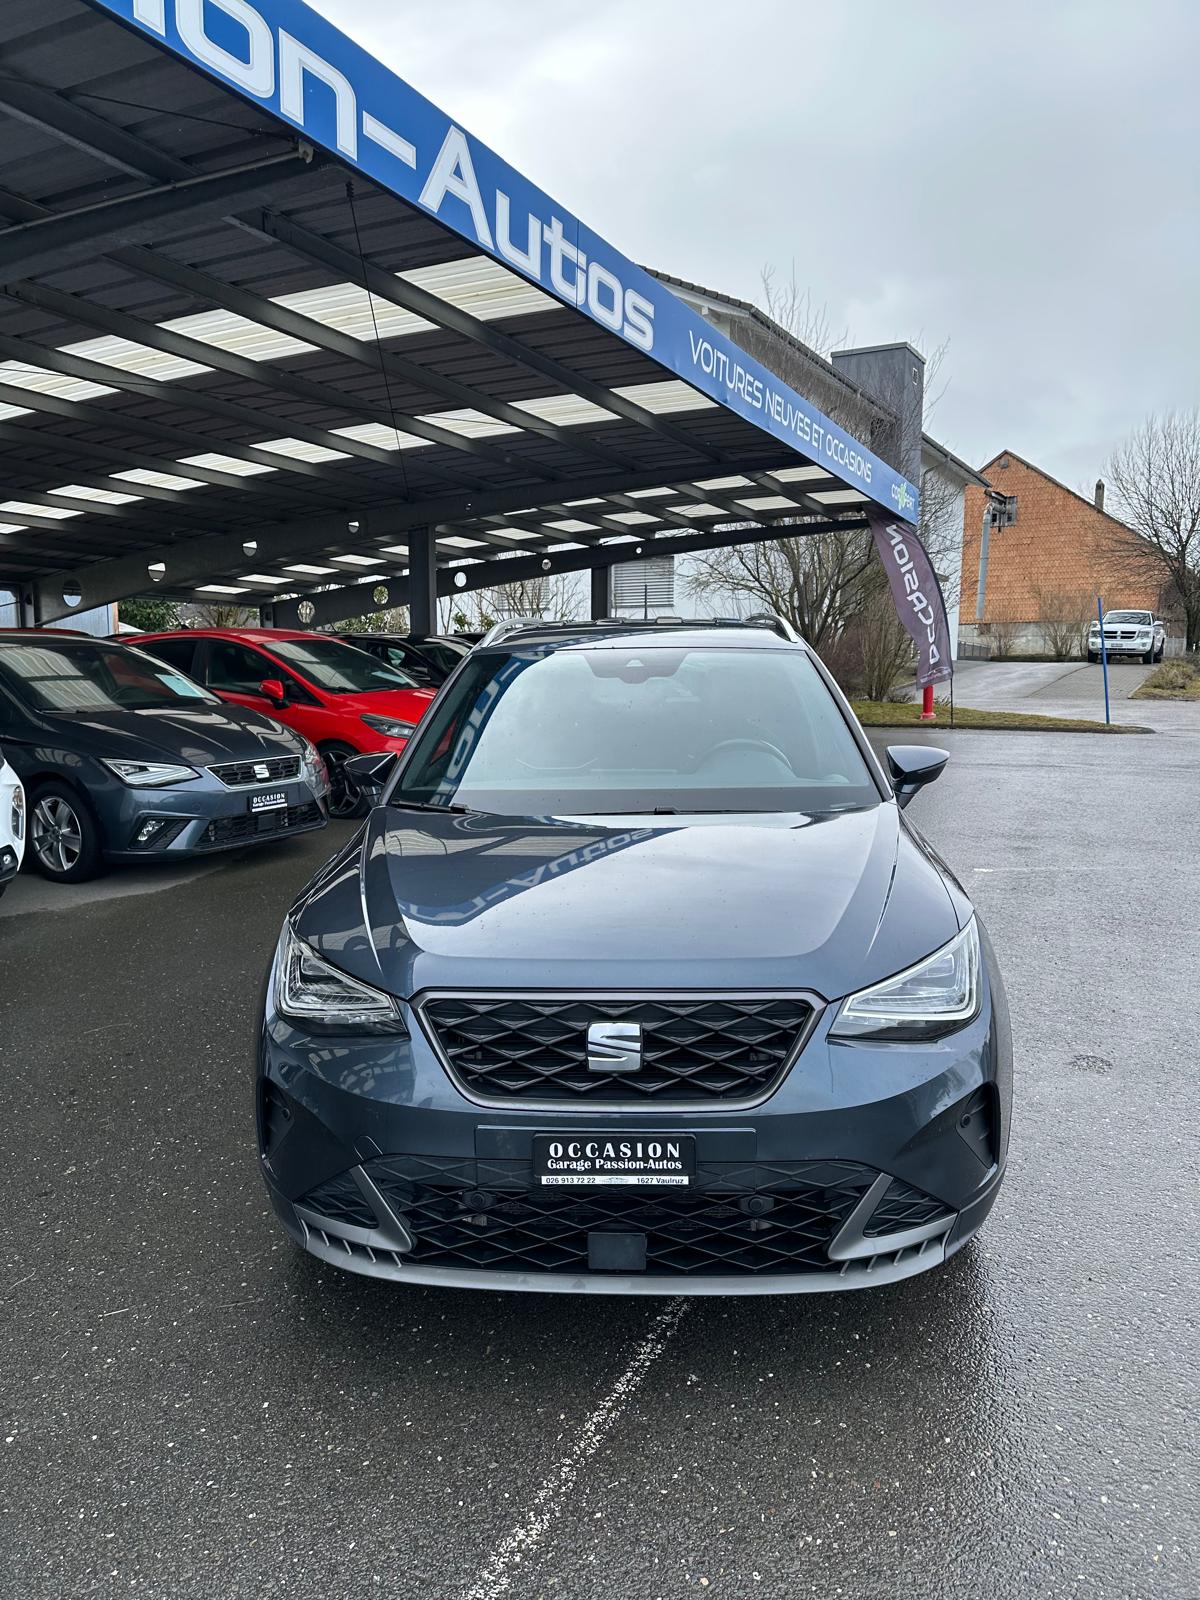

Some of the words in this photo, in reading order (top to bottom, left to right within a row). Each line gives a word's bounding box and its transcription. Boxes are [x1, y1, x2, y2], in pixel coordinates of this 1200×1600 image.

[689, 330, 763, 409] VOITURES
[765, 387, 811, 441] NEUVES
[812, 422, 825, 450] ET
[825, 434, 872, 483] OCCASIONS
[253, 793, 285, 804] OCCASION
[548, 1142, 681, 1158] OCCASION
[547, 1158, 592, 1171] Garage
[595, 1158, 683, 1170] Passion-Autos
